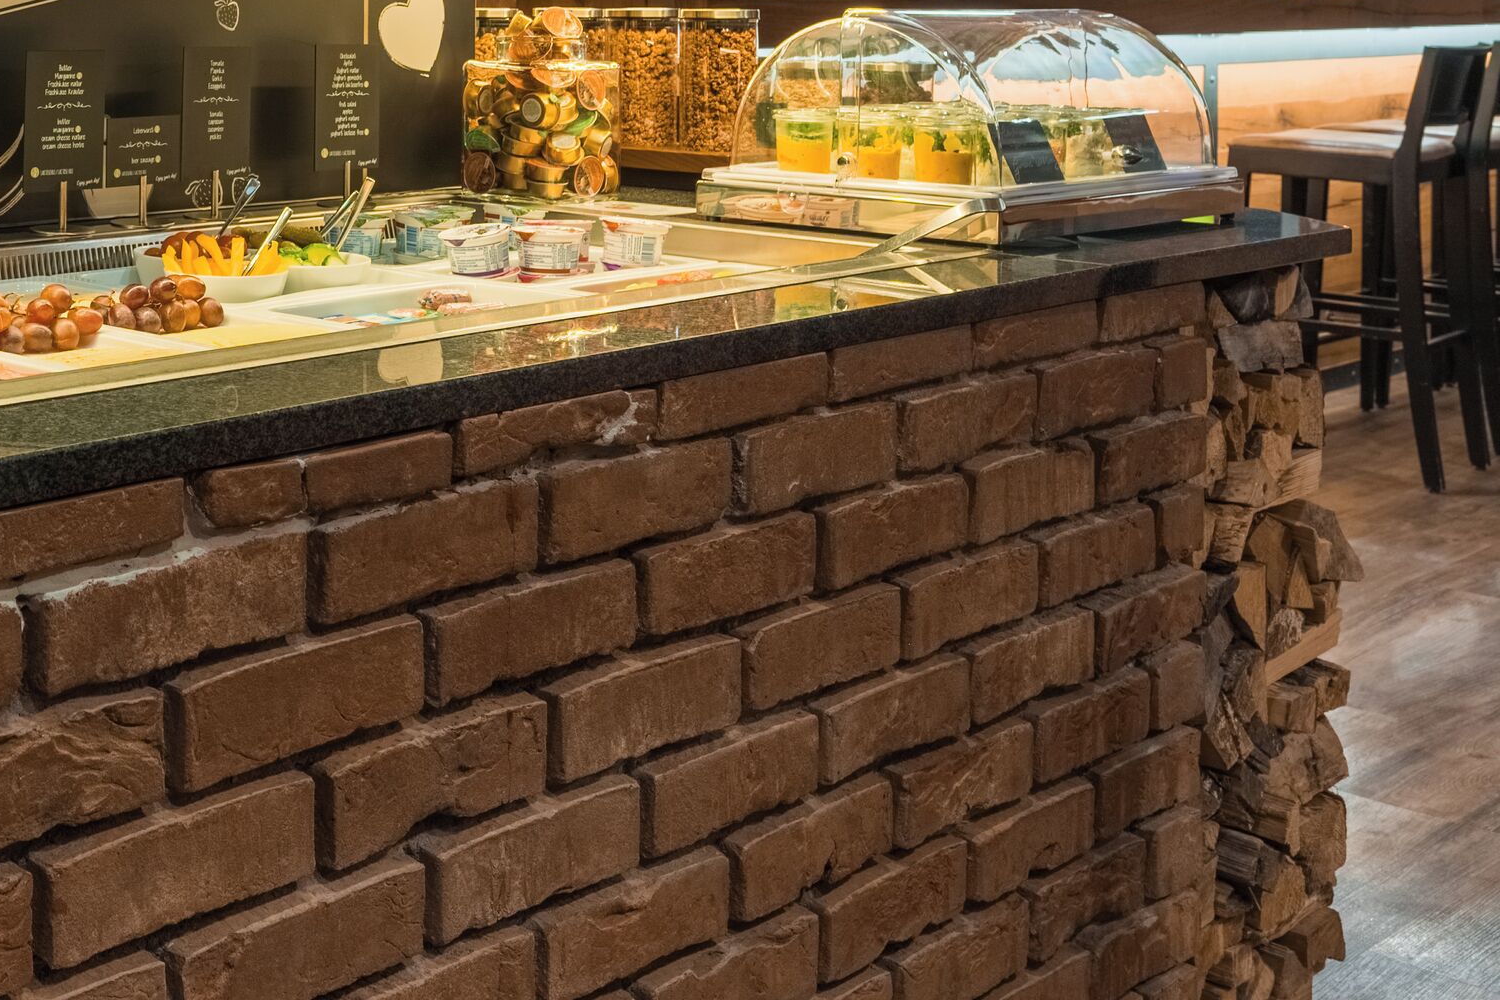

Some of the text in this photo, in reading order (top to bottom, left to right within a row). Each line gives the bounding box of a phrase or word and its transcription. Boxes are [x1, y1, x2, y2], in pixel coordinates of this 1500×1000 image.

[58, 64, 73, 72] Butter
[54, 72, 76, 81] Margarine
[56, 134, 71, 142] cheese
[57, 142, 72, 150] cheese
